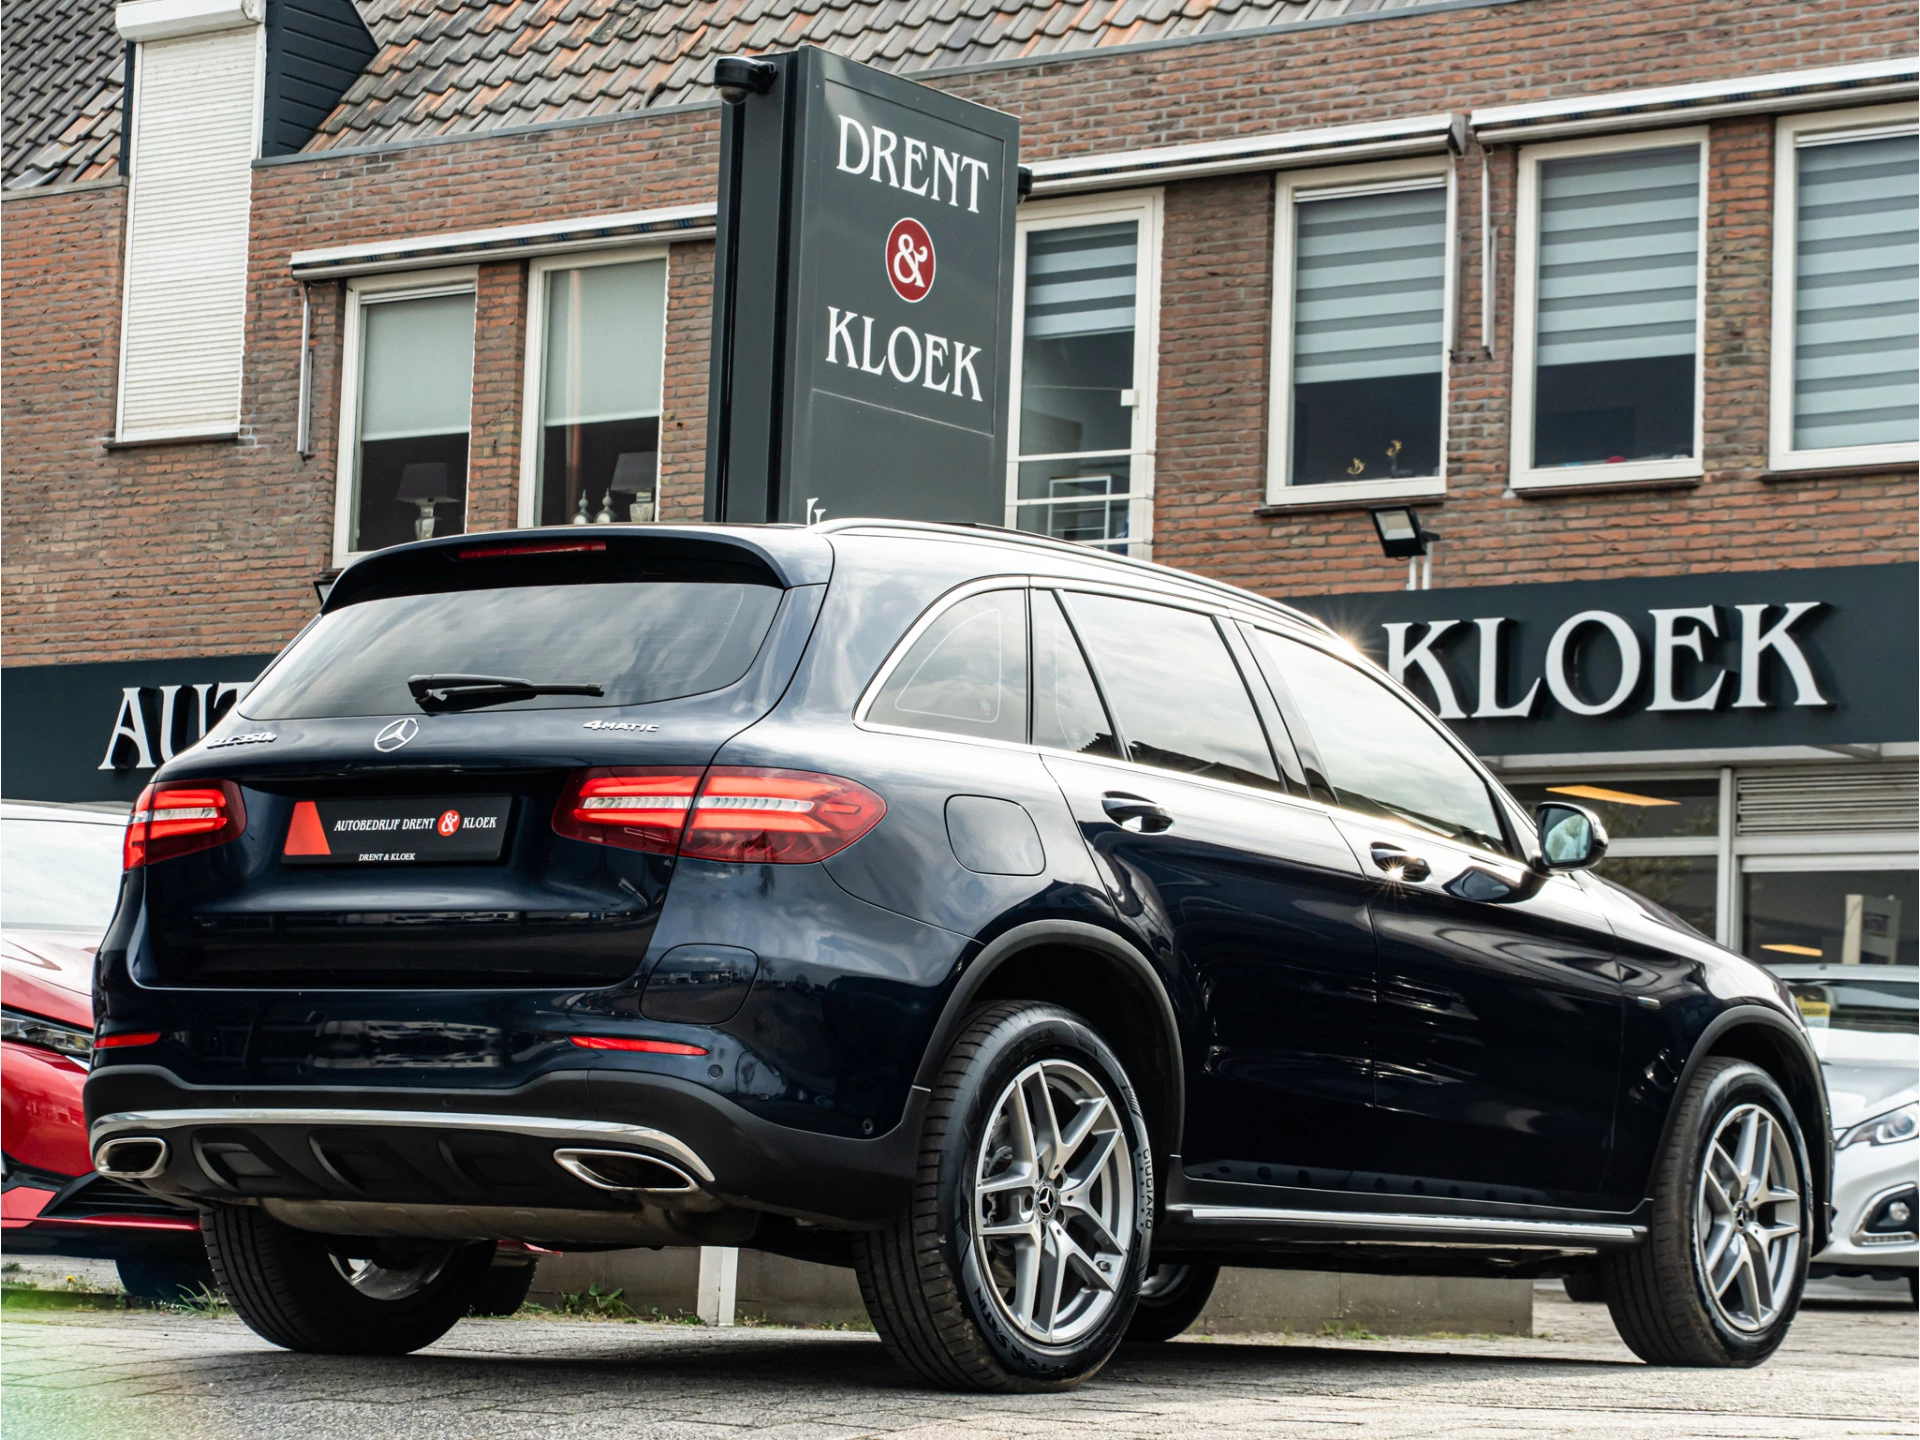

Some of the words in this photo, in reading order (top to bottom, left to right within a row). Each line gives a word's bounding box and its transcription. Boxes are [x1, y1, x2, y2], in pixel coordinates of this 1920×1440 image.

[836, 114, 990, 213] DRENT
[893, 233, 928, 288] &
[825, 306, 983, 402] KLOEK
[1381, 601, 1828, 719] KLOEK
[582, 719, 660, 732] 4MATIC
[333, 819, 401, 832] AUTOBEDRIJF
[402, 817, 436, 830] DRENT
[440, 812, 458, 833] &
[462, 816, 498, 829] KLOEK
[358, 853, 384, 861] DRENT
[390, 852, 416, 861] KLOEK
[1143, 1148, 1154, 1230] GIUGIARO
